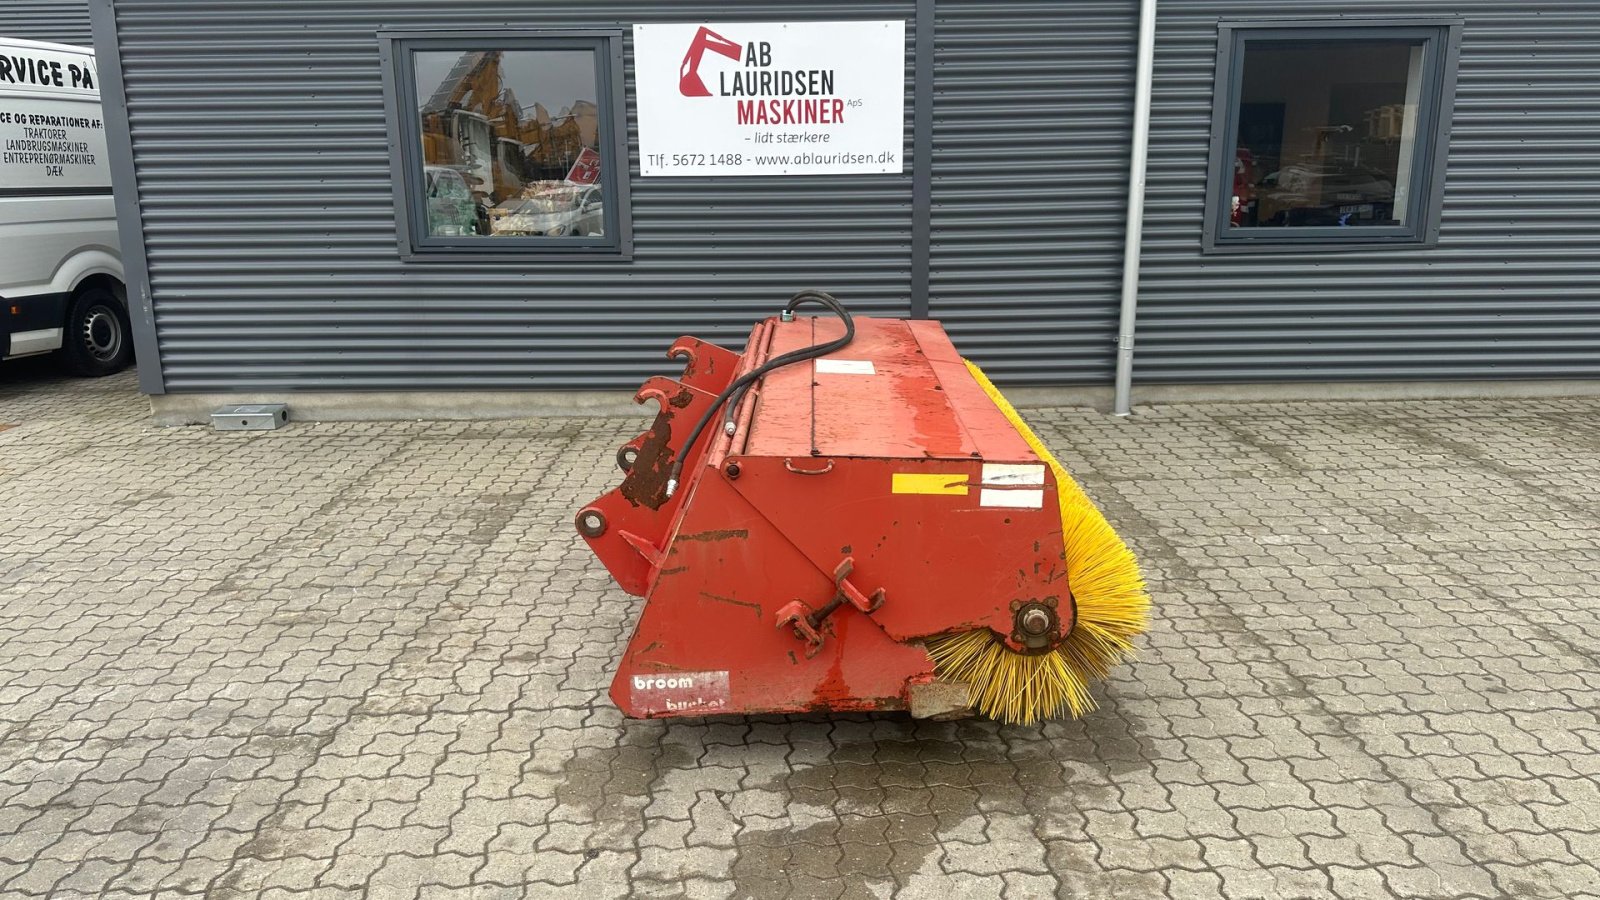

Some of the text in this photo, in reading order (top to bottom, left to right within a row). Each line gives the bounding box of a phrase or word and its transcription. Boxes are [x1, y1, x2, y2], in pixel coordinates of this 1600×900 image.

[745, 41, 771, 67] AB
[68, 62, 94, 89] PÅ
[720, 70, 834, 96] LAURIDSEN
[737, 98, 862, 124] MASKINER ApS
[14, 114, 27, 125] OG
[29, 114, 90, 129] REPARATIONER
[91, 120, 104, 129] AF:
[24, 127, 67, 140] TRAKTORER
[754, 132, 774, 143] lidt
[776, 132, 830, 143] stærkere
[6, 139, 88, 153] LANDBRUGSMASKINER
[3, 152, 96, 165] ENTREPRENØRMASKINER
[648, 154, 668, 169] Tlf.
[672, 154, 705, 166] 5672
[710, 153, 742, 165] 1488
[755, 152, 895, 165] www.ablauridsen.dk
[46, 166, 64, 177] DÆK
[634, 676, 693, 690] broom
